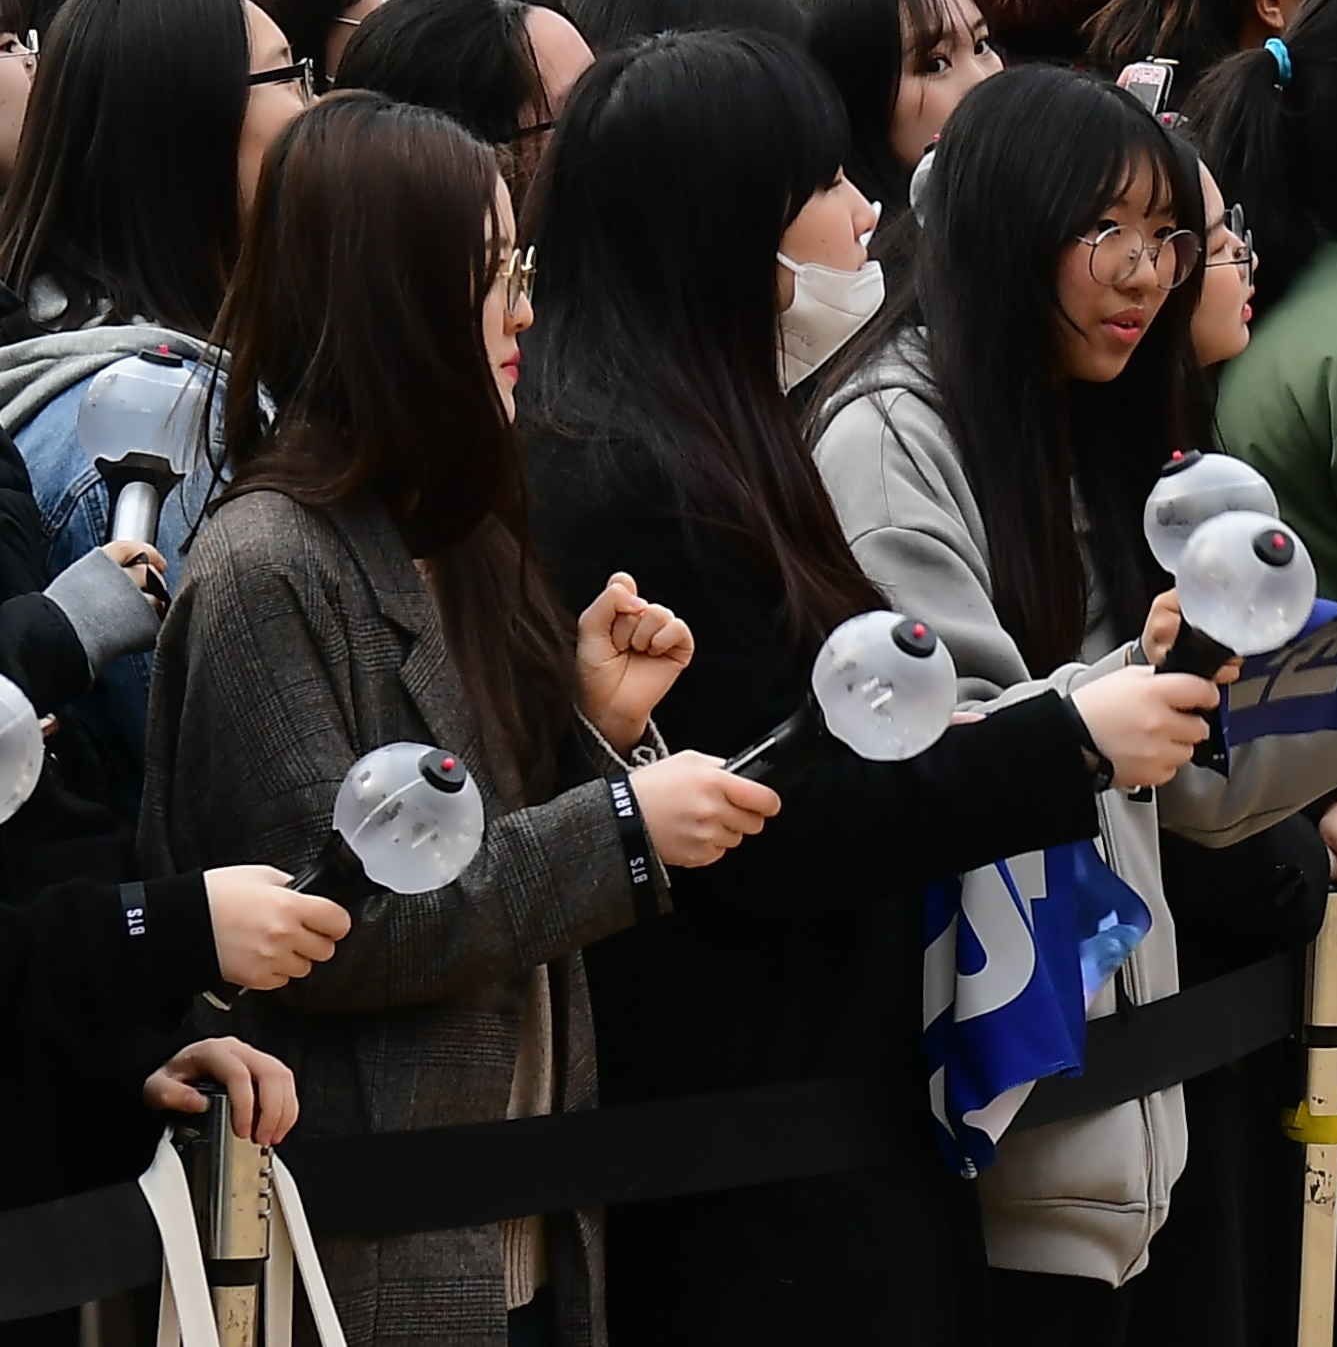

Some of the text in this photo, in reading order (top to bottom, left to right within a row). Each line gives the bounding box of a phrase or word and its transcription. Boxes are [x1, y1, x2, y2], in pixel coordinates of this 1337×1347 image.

[610, 781, 636, 818] ARMY
[630, 856, 648, 884] BTS
[127, 906, 146, 936] BTS
